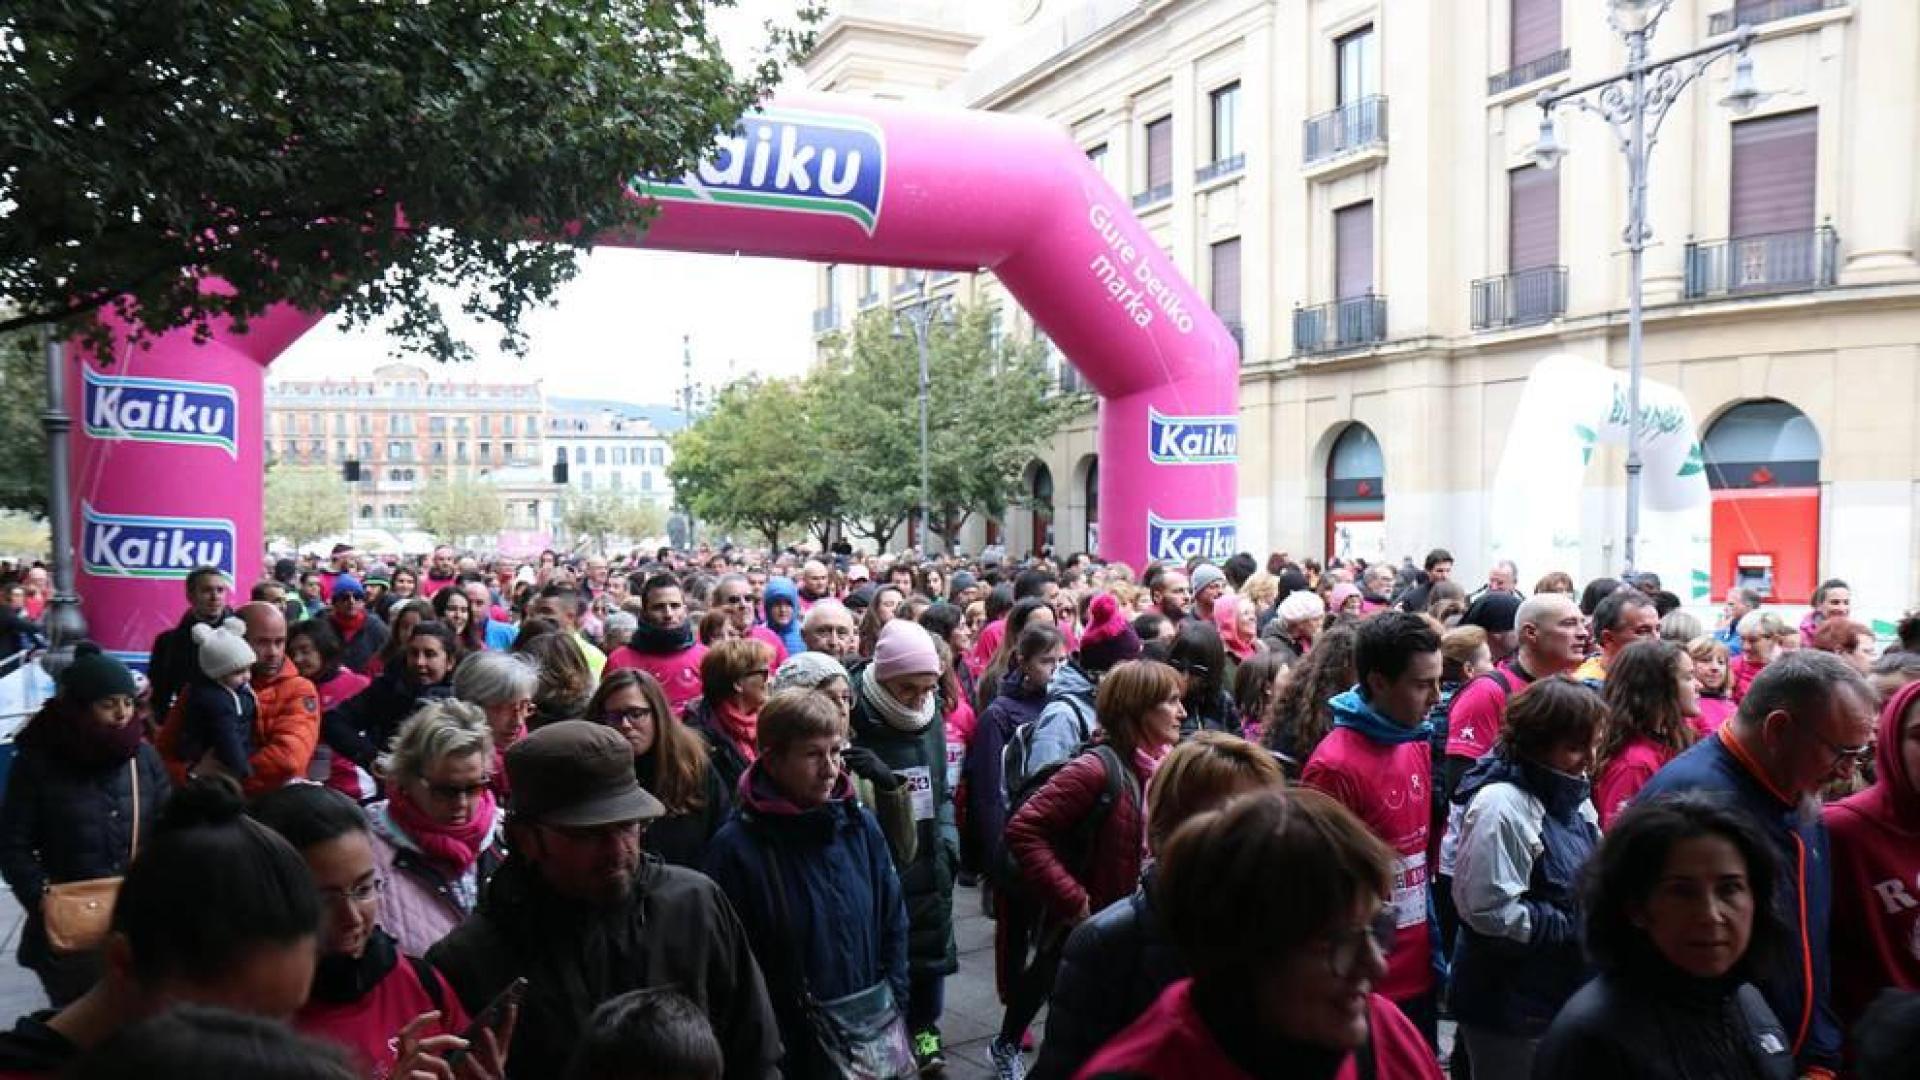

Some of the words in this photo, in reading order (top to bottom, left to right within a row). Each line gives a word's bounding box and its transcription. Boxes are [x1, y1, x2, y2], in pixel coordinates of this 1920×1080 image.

[683, 124, 862, 200] aiku
[1089, 204, 1136, 264] Gure
[1133, 255, 1194, 333] betiko
[1090, 255, 1153, 328] marka
[92, 386, 226, 438] Kaiku
[1159, 422, 1237, 463] Kaiku
[92, 524, 224, 575] Kaiku
[1158, 527, 1236, 568] Kaiku
